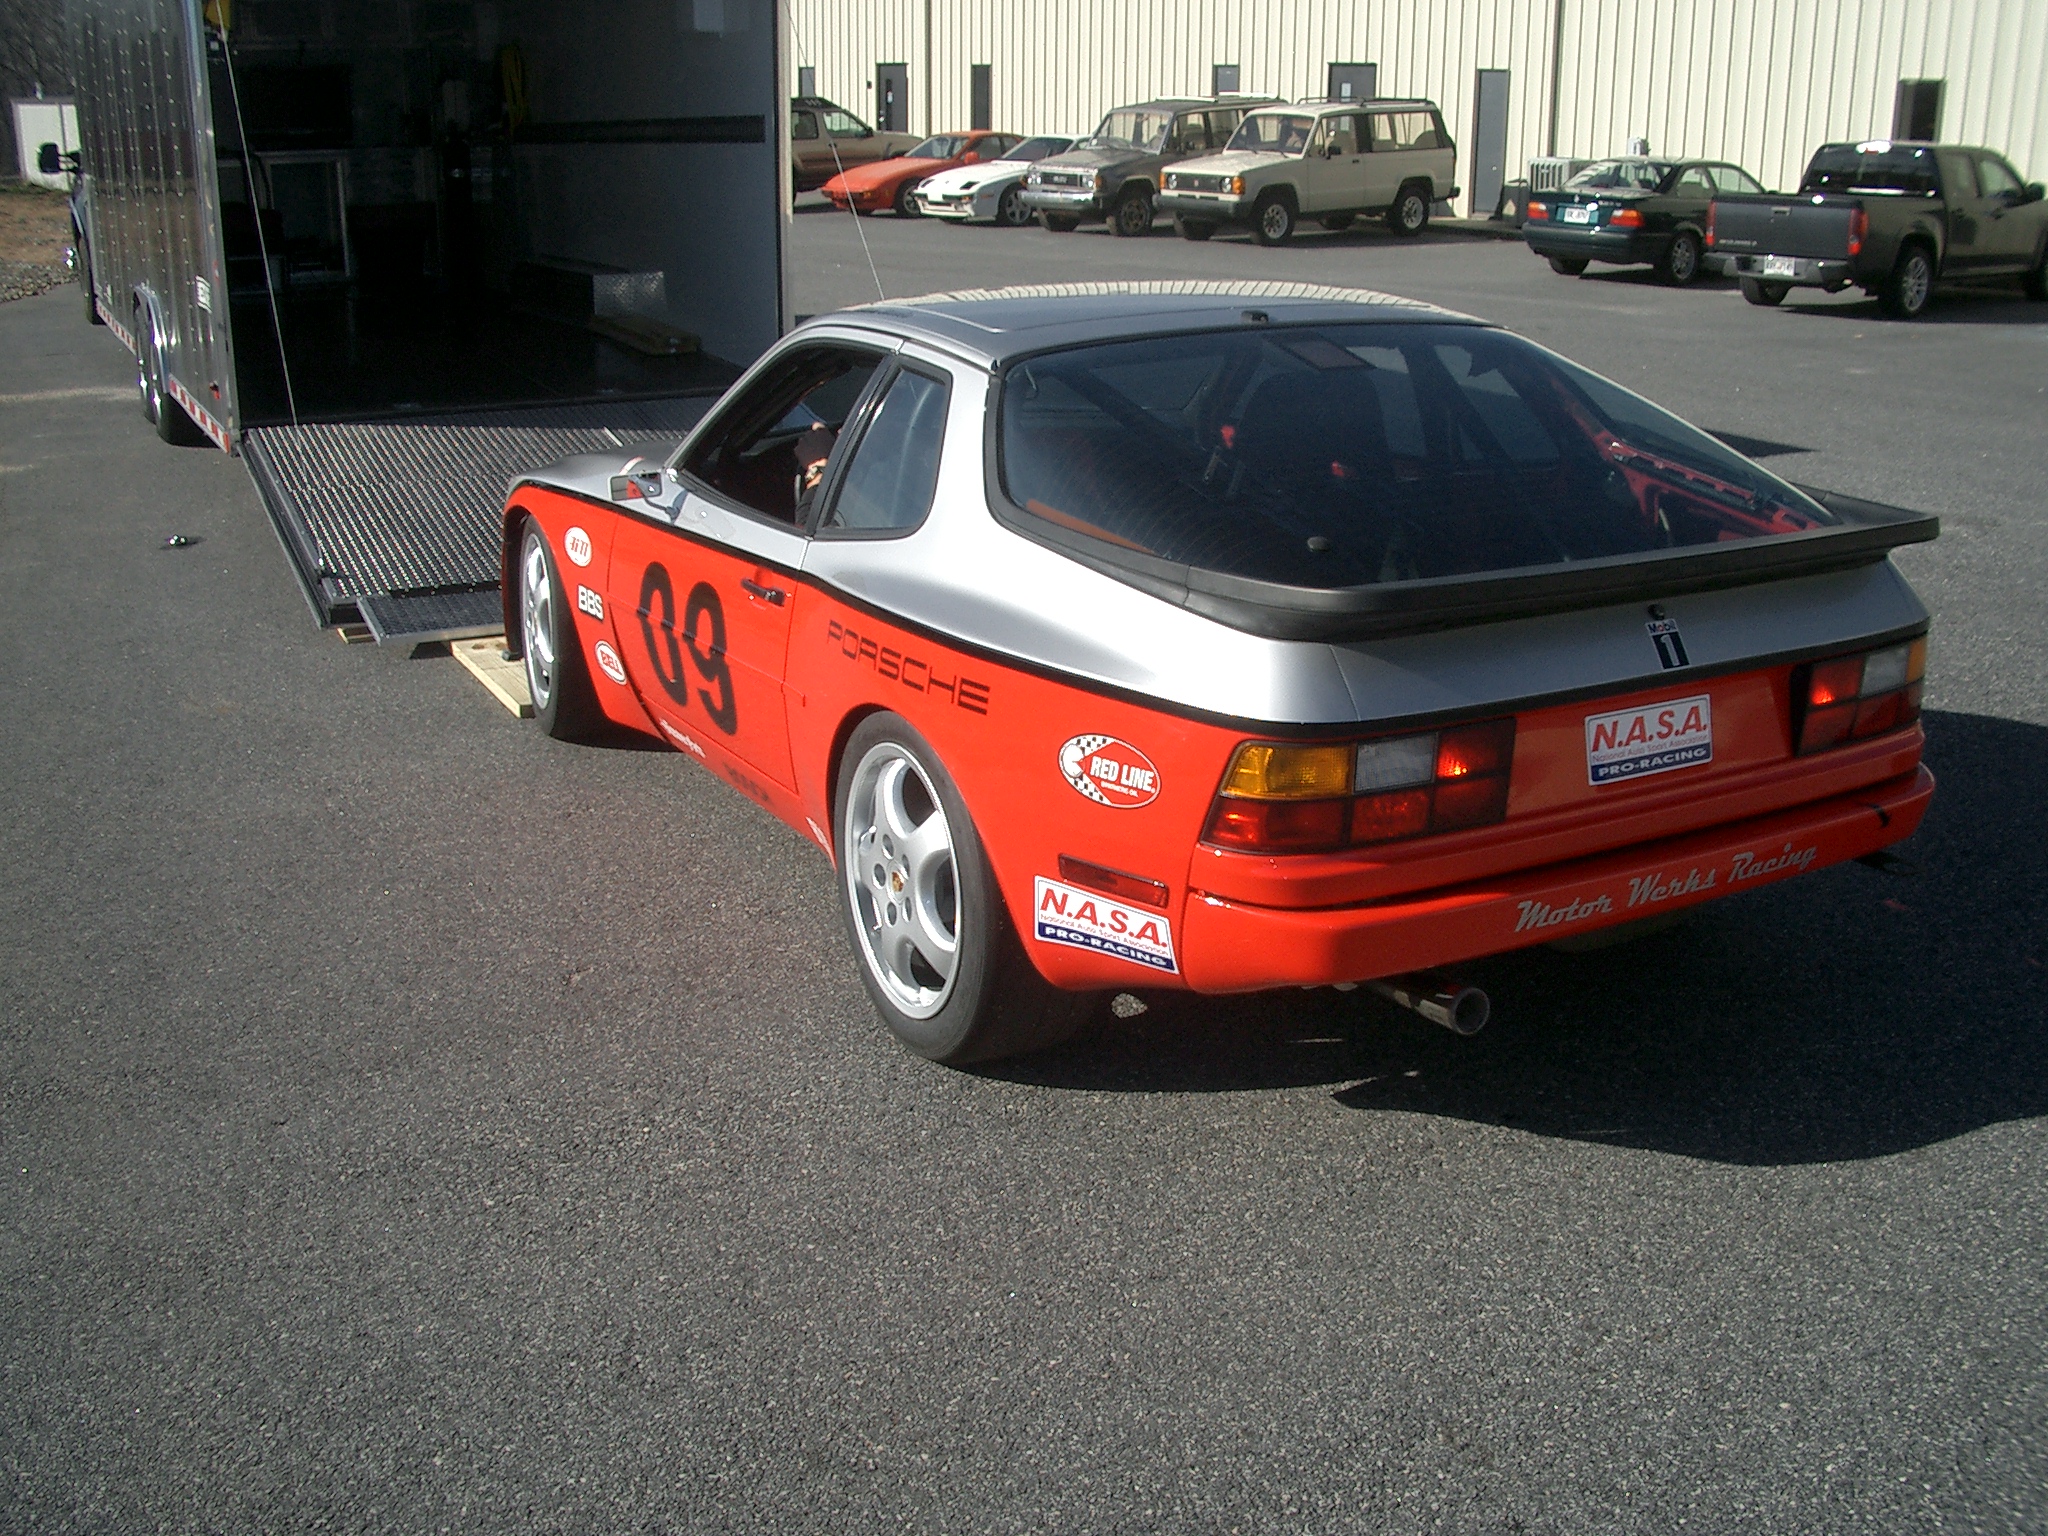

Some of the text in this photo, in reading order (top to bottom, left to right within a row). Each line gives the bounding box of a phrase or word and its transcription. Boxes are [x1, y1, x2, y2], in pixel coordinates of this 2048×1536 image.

[578, 584, 604, 621] BBS
[637, 561, 738, 736] 09
[827, 620, 990, 715] PORSCHE
[1660, 634, 1680, 666] 1
[1592, 705, 1707, 752] N.A.S.A.
[1090, 755, 1120, 782] RED
[1120, 764, 1155, 792] LINE
[1598, 748, 1707, 776] PRO-RACING
[1515, 895, 1613, 932] Motor
[1728, 843, 1817, 883] Racing
[1040, 888, 1167, 947] N.A.S.A.
[1045, 926, 1166, 966] PRO-RACING
